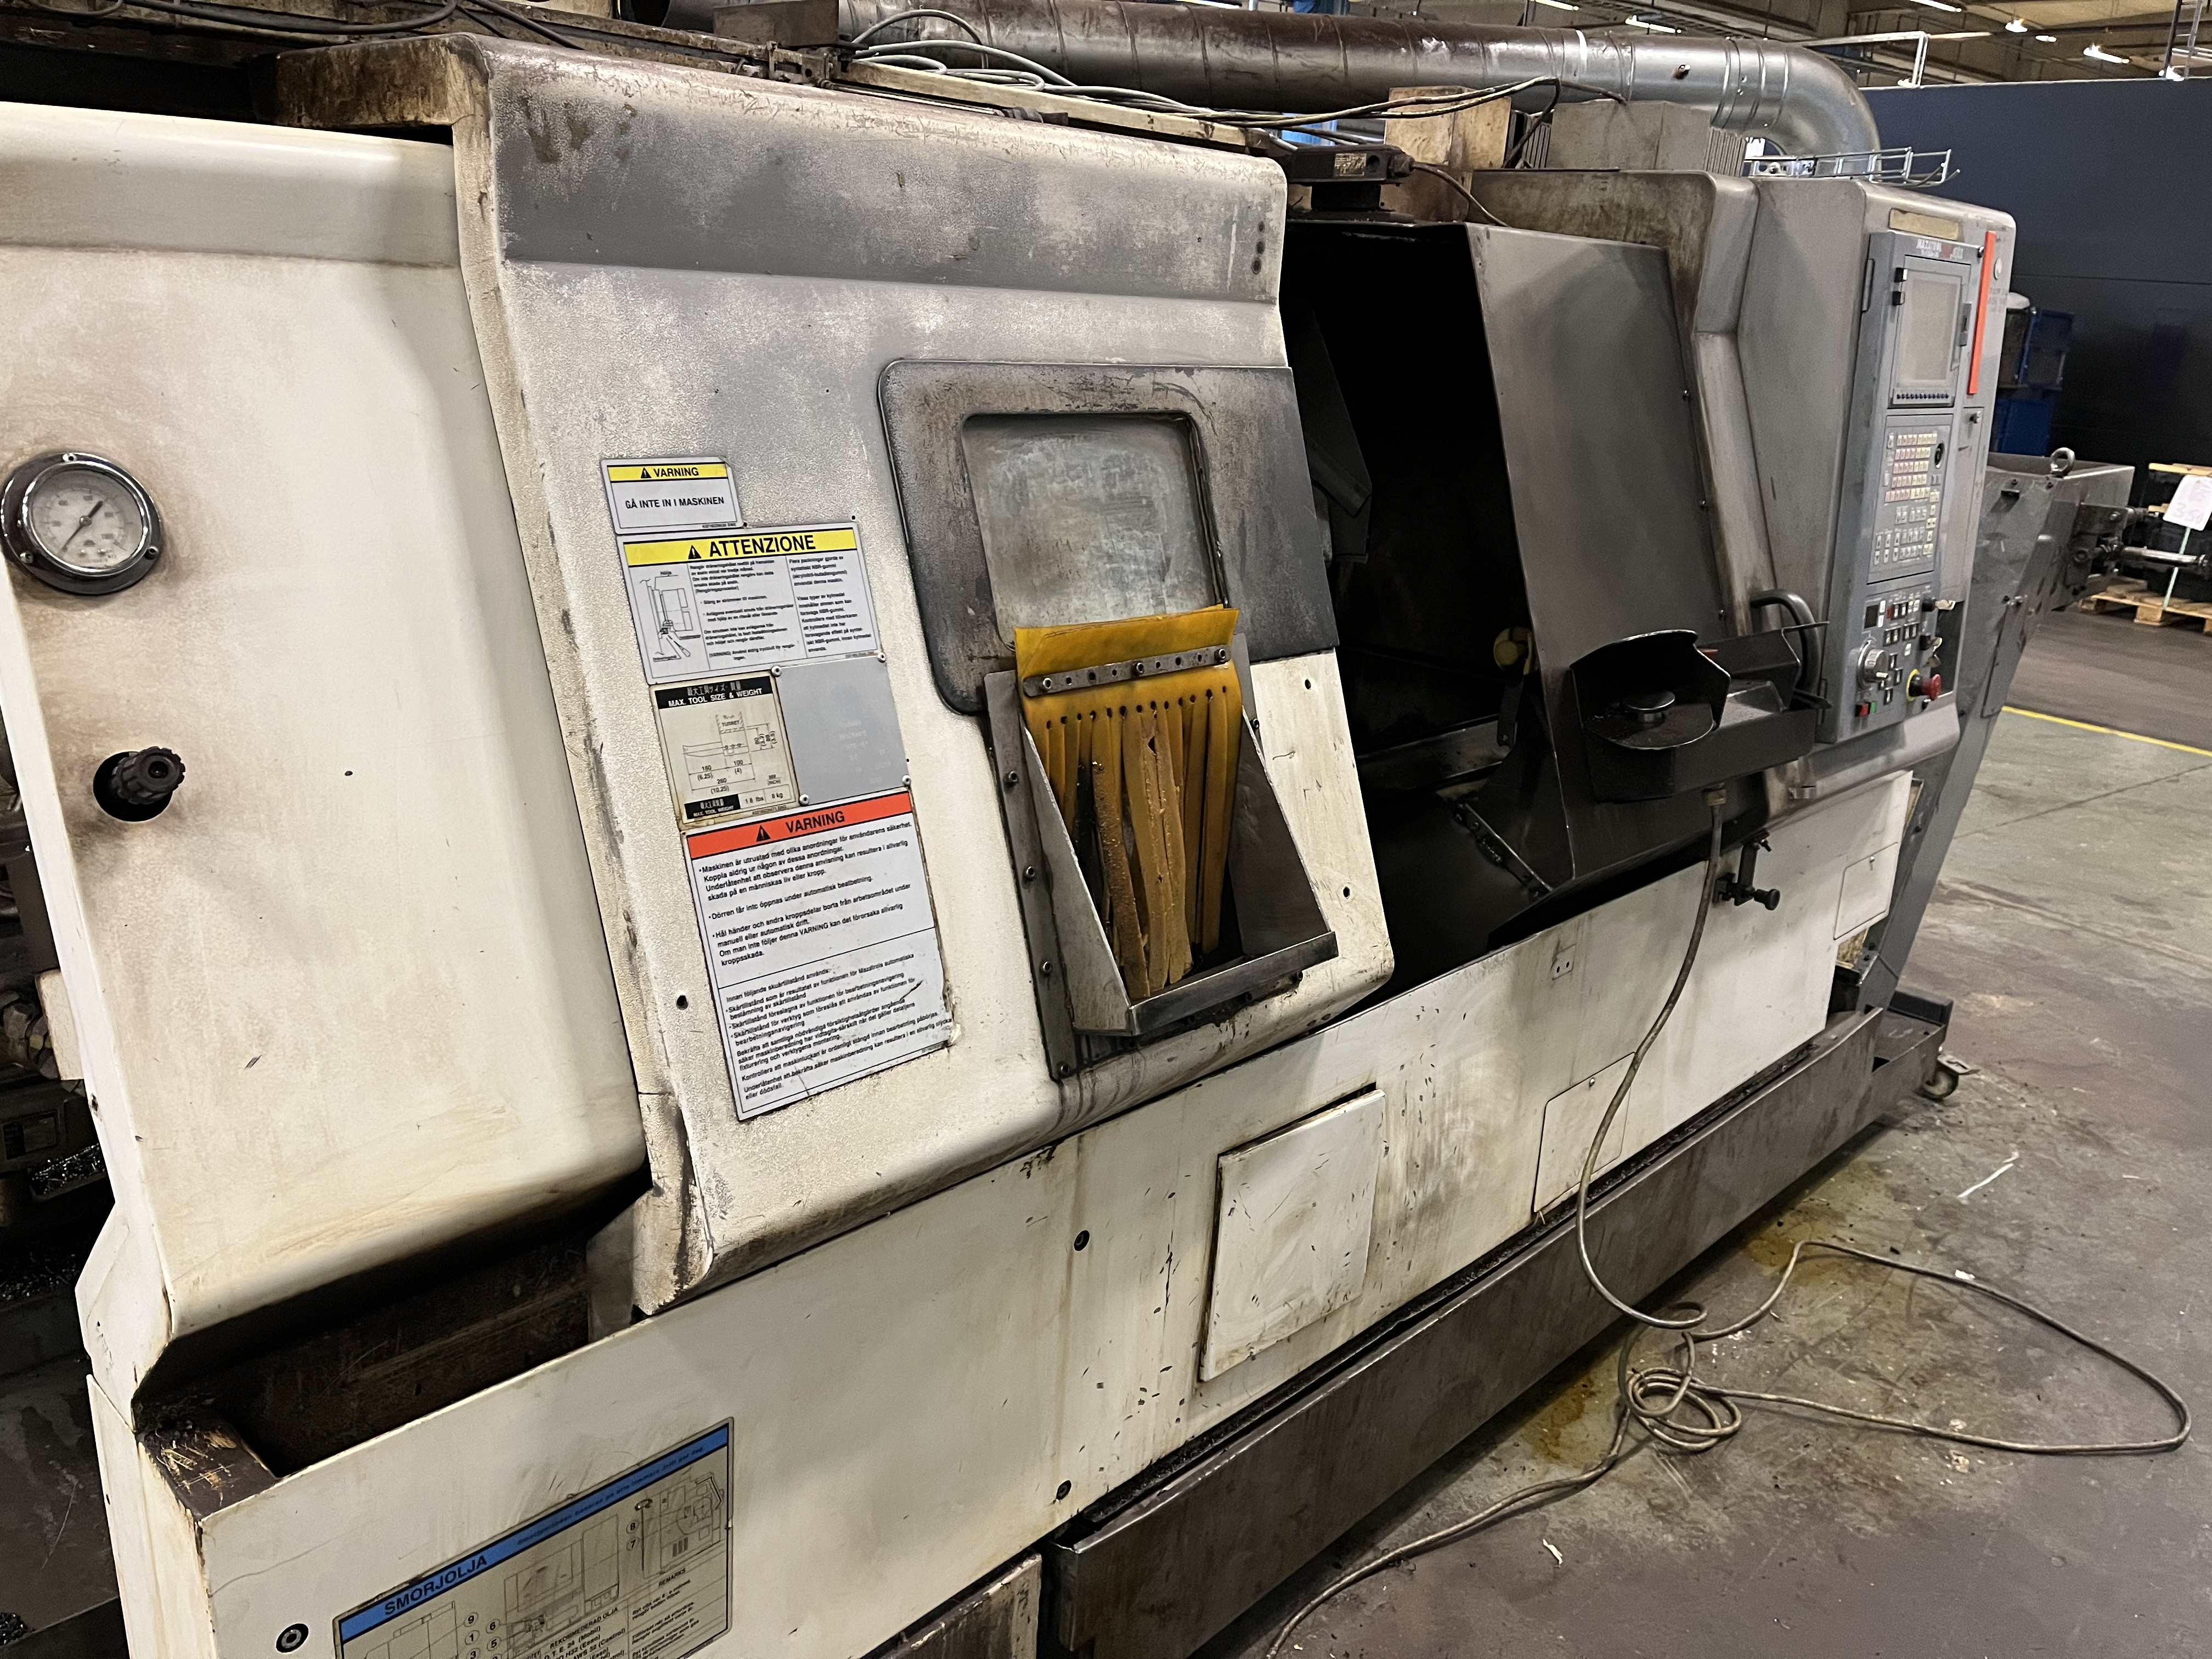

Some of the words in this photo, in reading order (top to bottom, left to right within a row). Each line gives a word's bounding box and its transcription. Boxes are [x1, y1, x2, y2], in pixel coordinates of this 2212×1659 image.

[653, 467, 699, 477] VARNING
[625, 498, 638, 509] GÅ
[639, 499, 661, 508] INTE
[662, 499, 672, 507] IN
[679, 496, 724, 506] MASKINEN
[710, 535, 816, 557] ATTENZIONE
[688, 696, 708, 704] TOOL
[736, 688, 762, 697] WEIGHT
[786, 811, 845, 833] VARNING
[658, 1567, 686, 1587] REMARKS
[602, 1607, 618, 1619] OLJA
[467, 1616, 474, 1624] 9
[490, 1622, 496, 1630] 6
[469, 1633, 474, 1641] 1
[567, 1640, 574, 1649] 24
[579, 1626, 601, 1643] (Mobil)
[580, 1634, 601, 1650] (Esso)
[490, 1639, 498, 1648] 5
[589, 1644, 597, 1652] 32
[470, 1651, 477, 1659] 3
